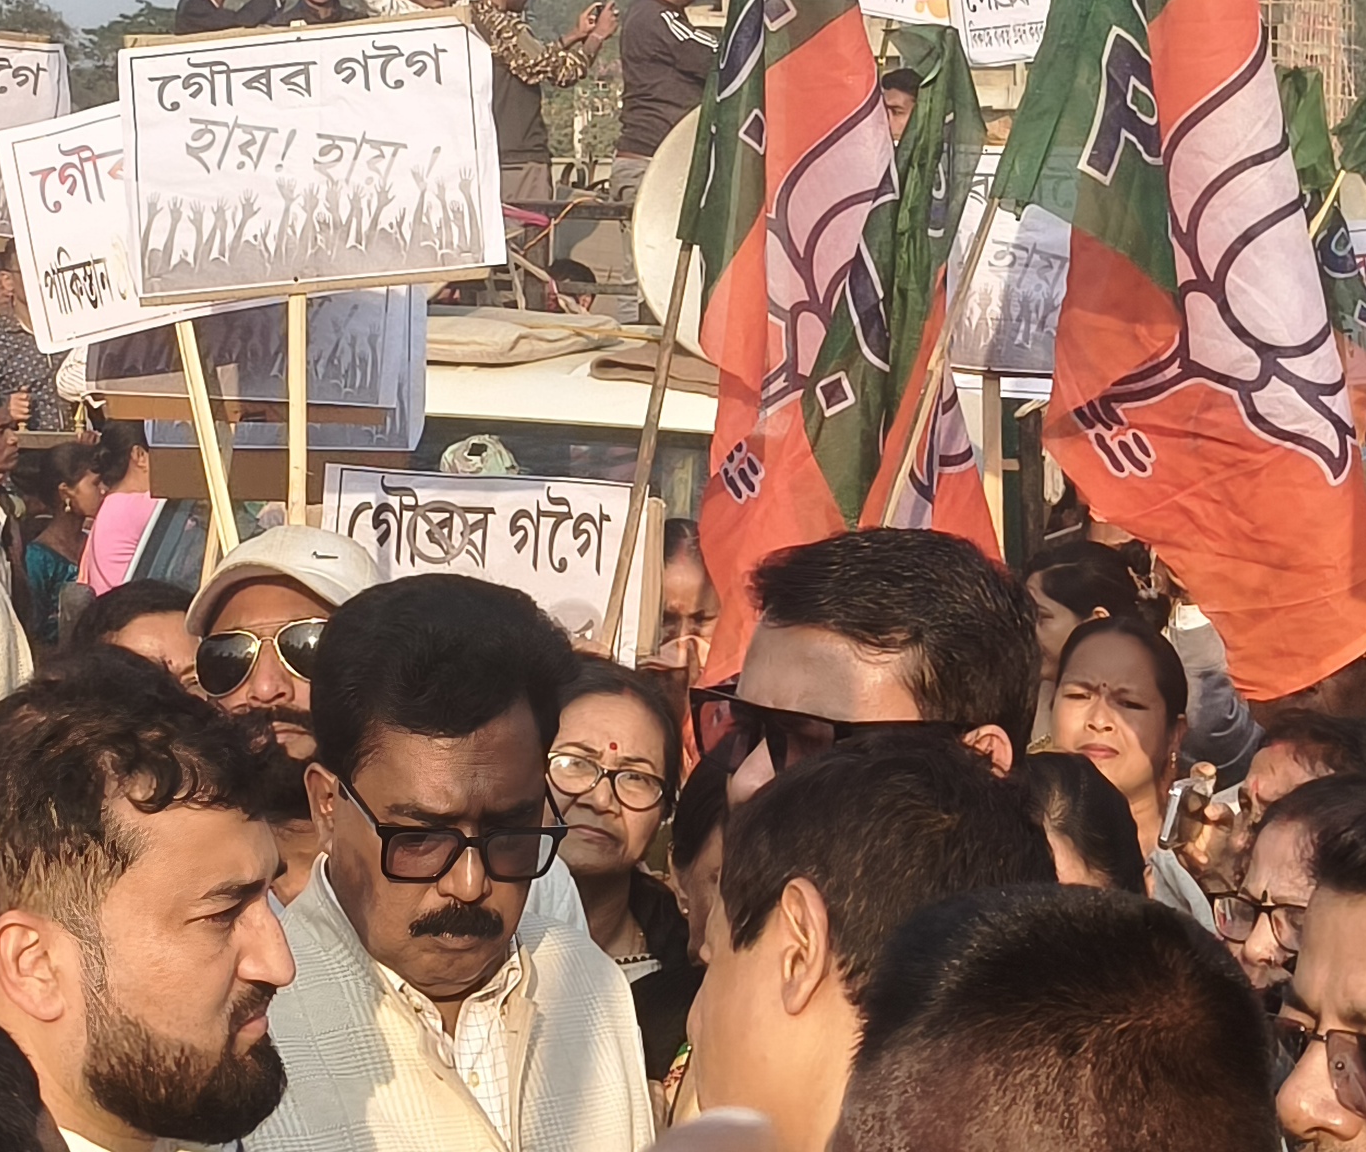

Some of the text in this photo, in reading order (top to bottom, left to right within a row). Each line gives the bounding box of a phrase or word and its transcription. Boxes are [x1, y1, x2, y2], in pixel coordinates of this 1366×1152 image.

[148, 40, 447, 111] গৌৰৱ গগৈ
[509, 486, 612, 575] গগৈ
